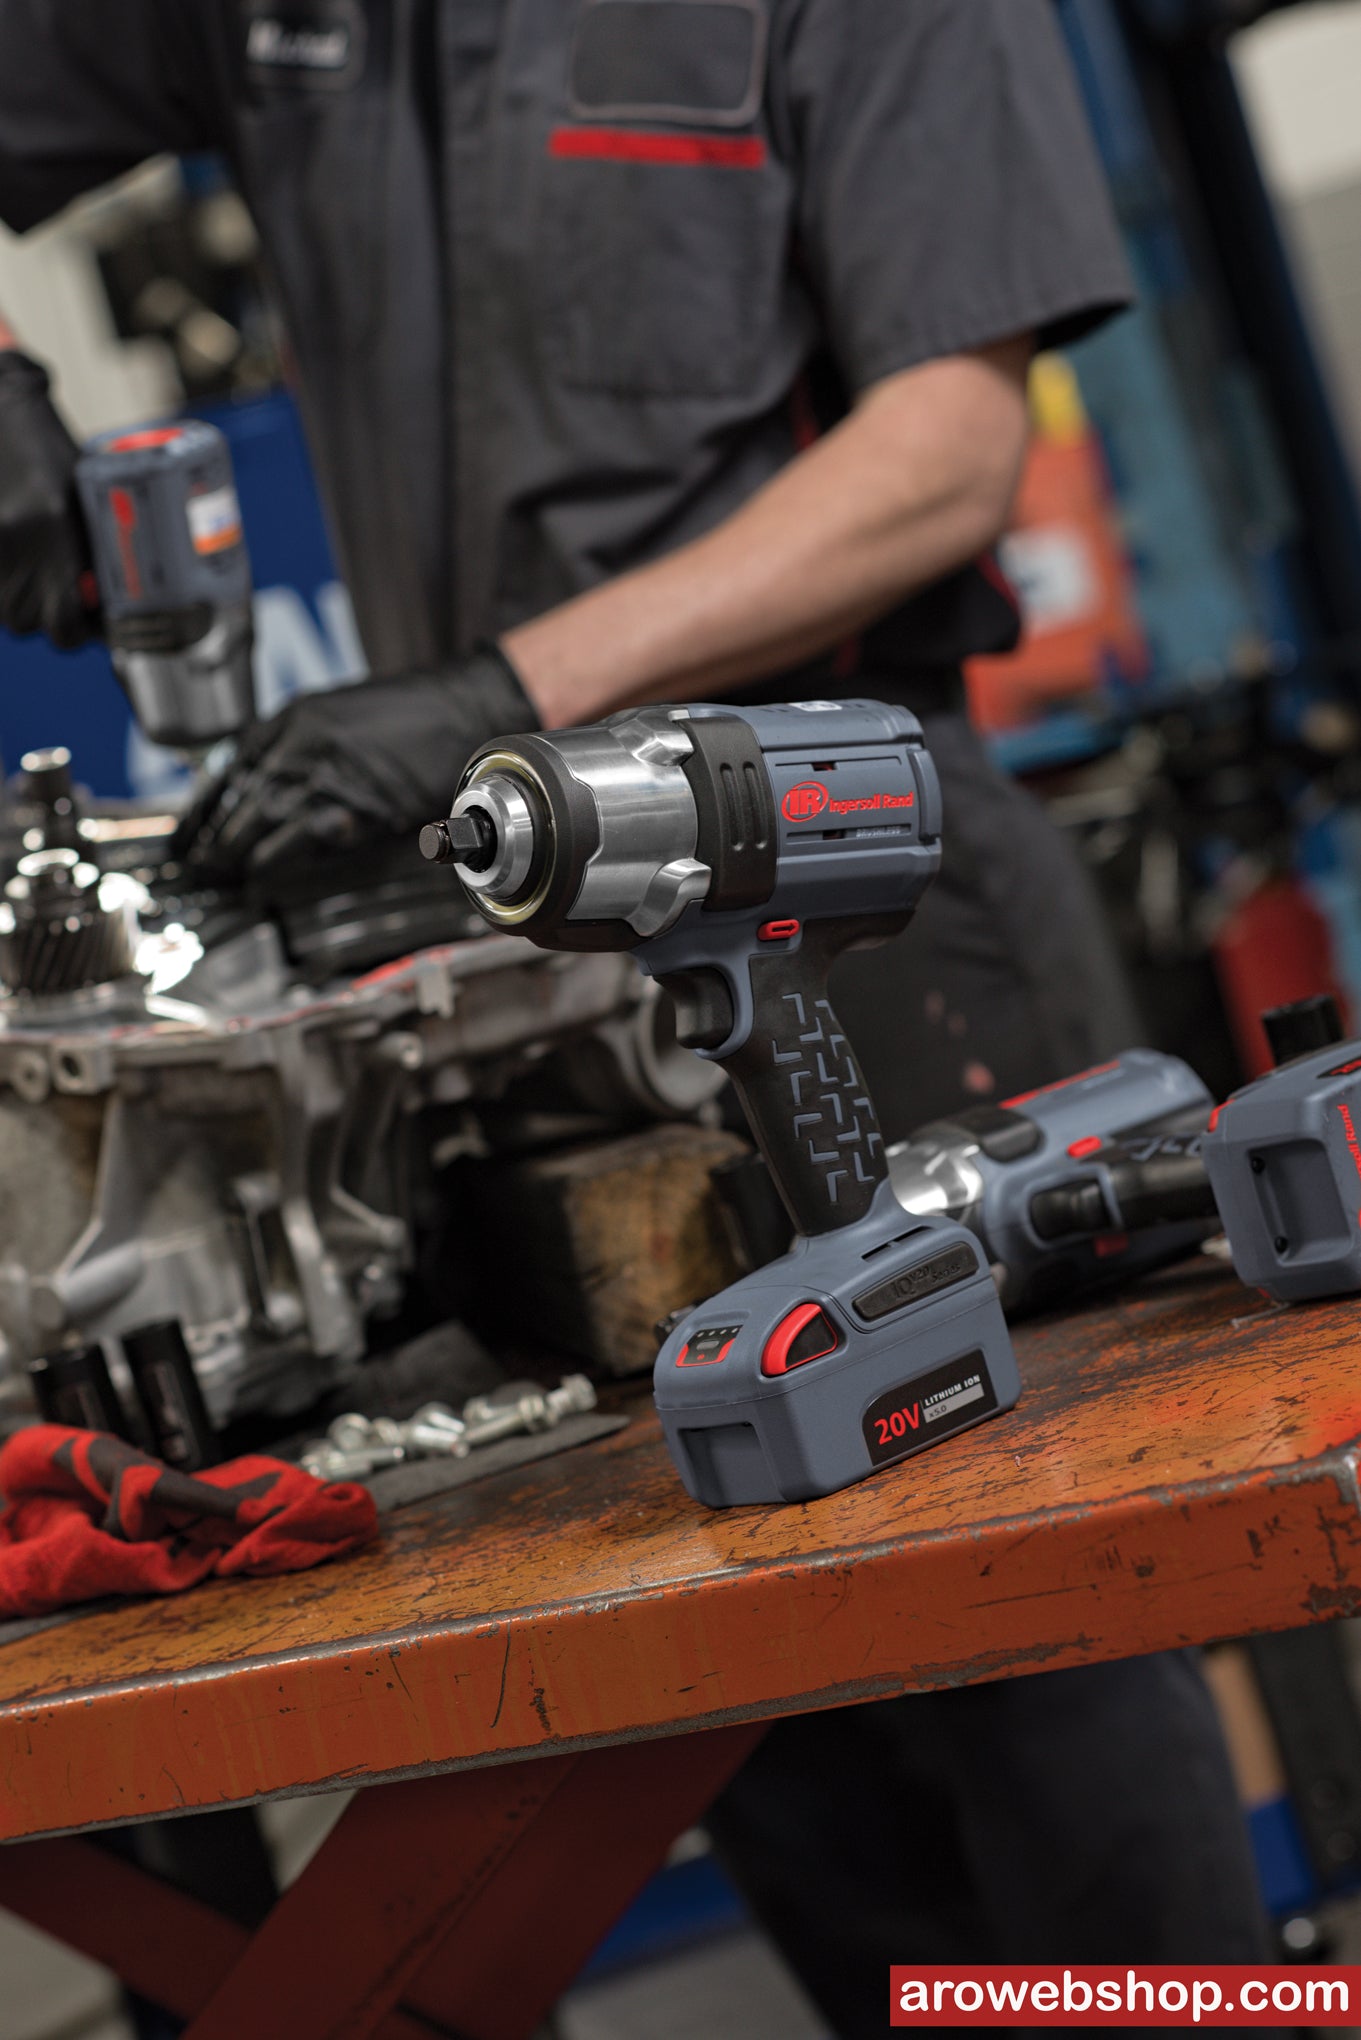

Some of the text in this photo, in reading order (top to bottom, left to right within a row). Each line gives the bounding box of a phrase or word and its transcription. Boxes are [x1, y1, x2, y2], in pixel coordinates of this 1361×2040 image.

[787, 787, 914, 817] IR Ingersoll Rand
[924, 1374, 981, 1407] LITHIUM ION
[873, 1402, 920, 1446] 20V
